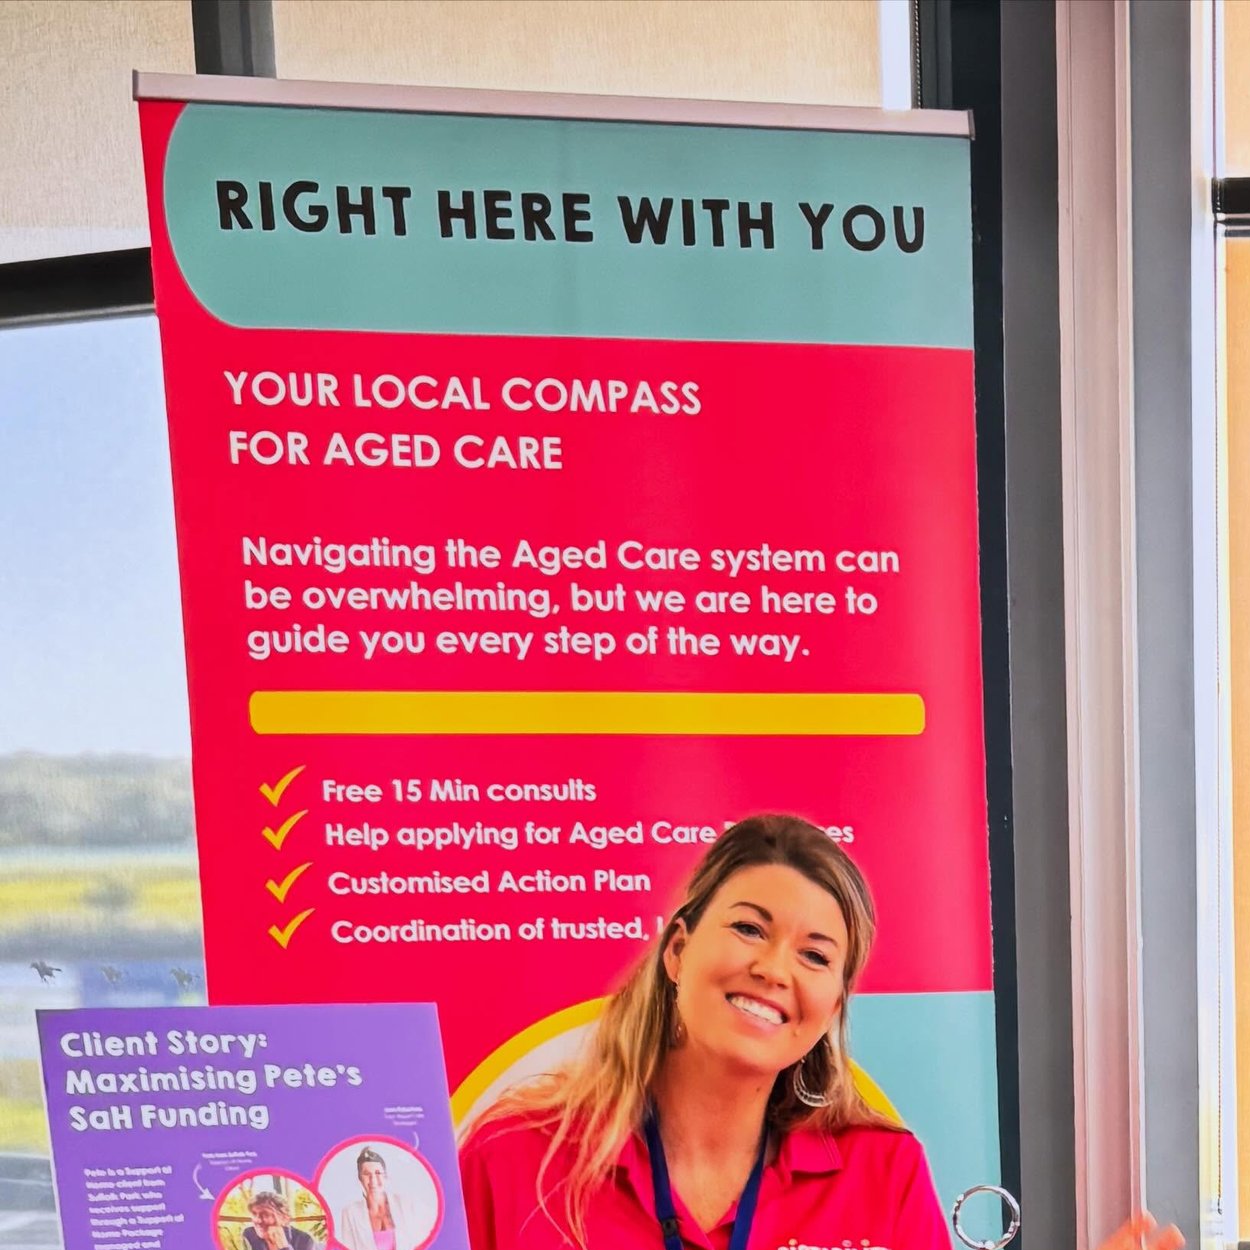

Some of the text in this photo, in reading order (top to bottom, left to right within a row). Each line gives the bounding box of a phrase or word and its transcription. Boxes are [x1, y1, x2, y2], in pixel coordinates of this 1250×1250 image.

[217, 181, 924, 253] RIGHT HERE WITH YOU
[224, 371, 701, 414] YOUR LOCAL COMPASS
[230, 431, 562, 469] FOR AGED CARE
[243, 537, 899, 577] Navigating the Aged Care system can
[245, 580, 877, 617] be overwhelming, but we are here to
[248, 624, 809, 661] guide you every step of the way.
[323, 779, 596, 802] Free 15 Min consults
[326, 823, 389, 850] Help
[397, 822, 518, 850] applying
[525, 822, 560, 844] for
[570, 822, 643, 849] Aged
[652, 822, 717, 843] Care
[329, 870, 650, 894] Customised Action Plan
[332, 919, 510, 942] Coordination
[519, 918, 544, 940] of
[551, 917, 649, 940] trusted,
[61, 1031, 267, 1057] Client Story:
[67, 1066, 256, 1094] Maximising
[70, 1102, 269, 1131] SaH Funding
